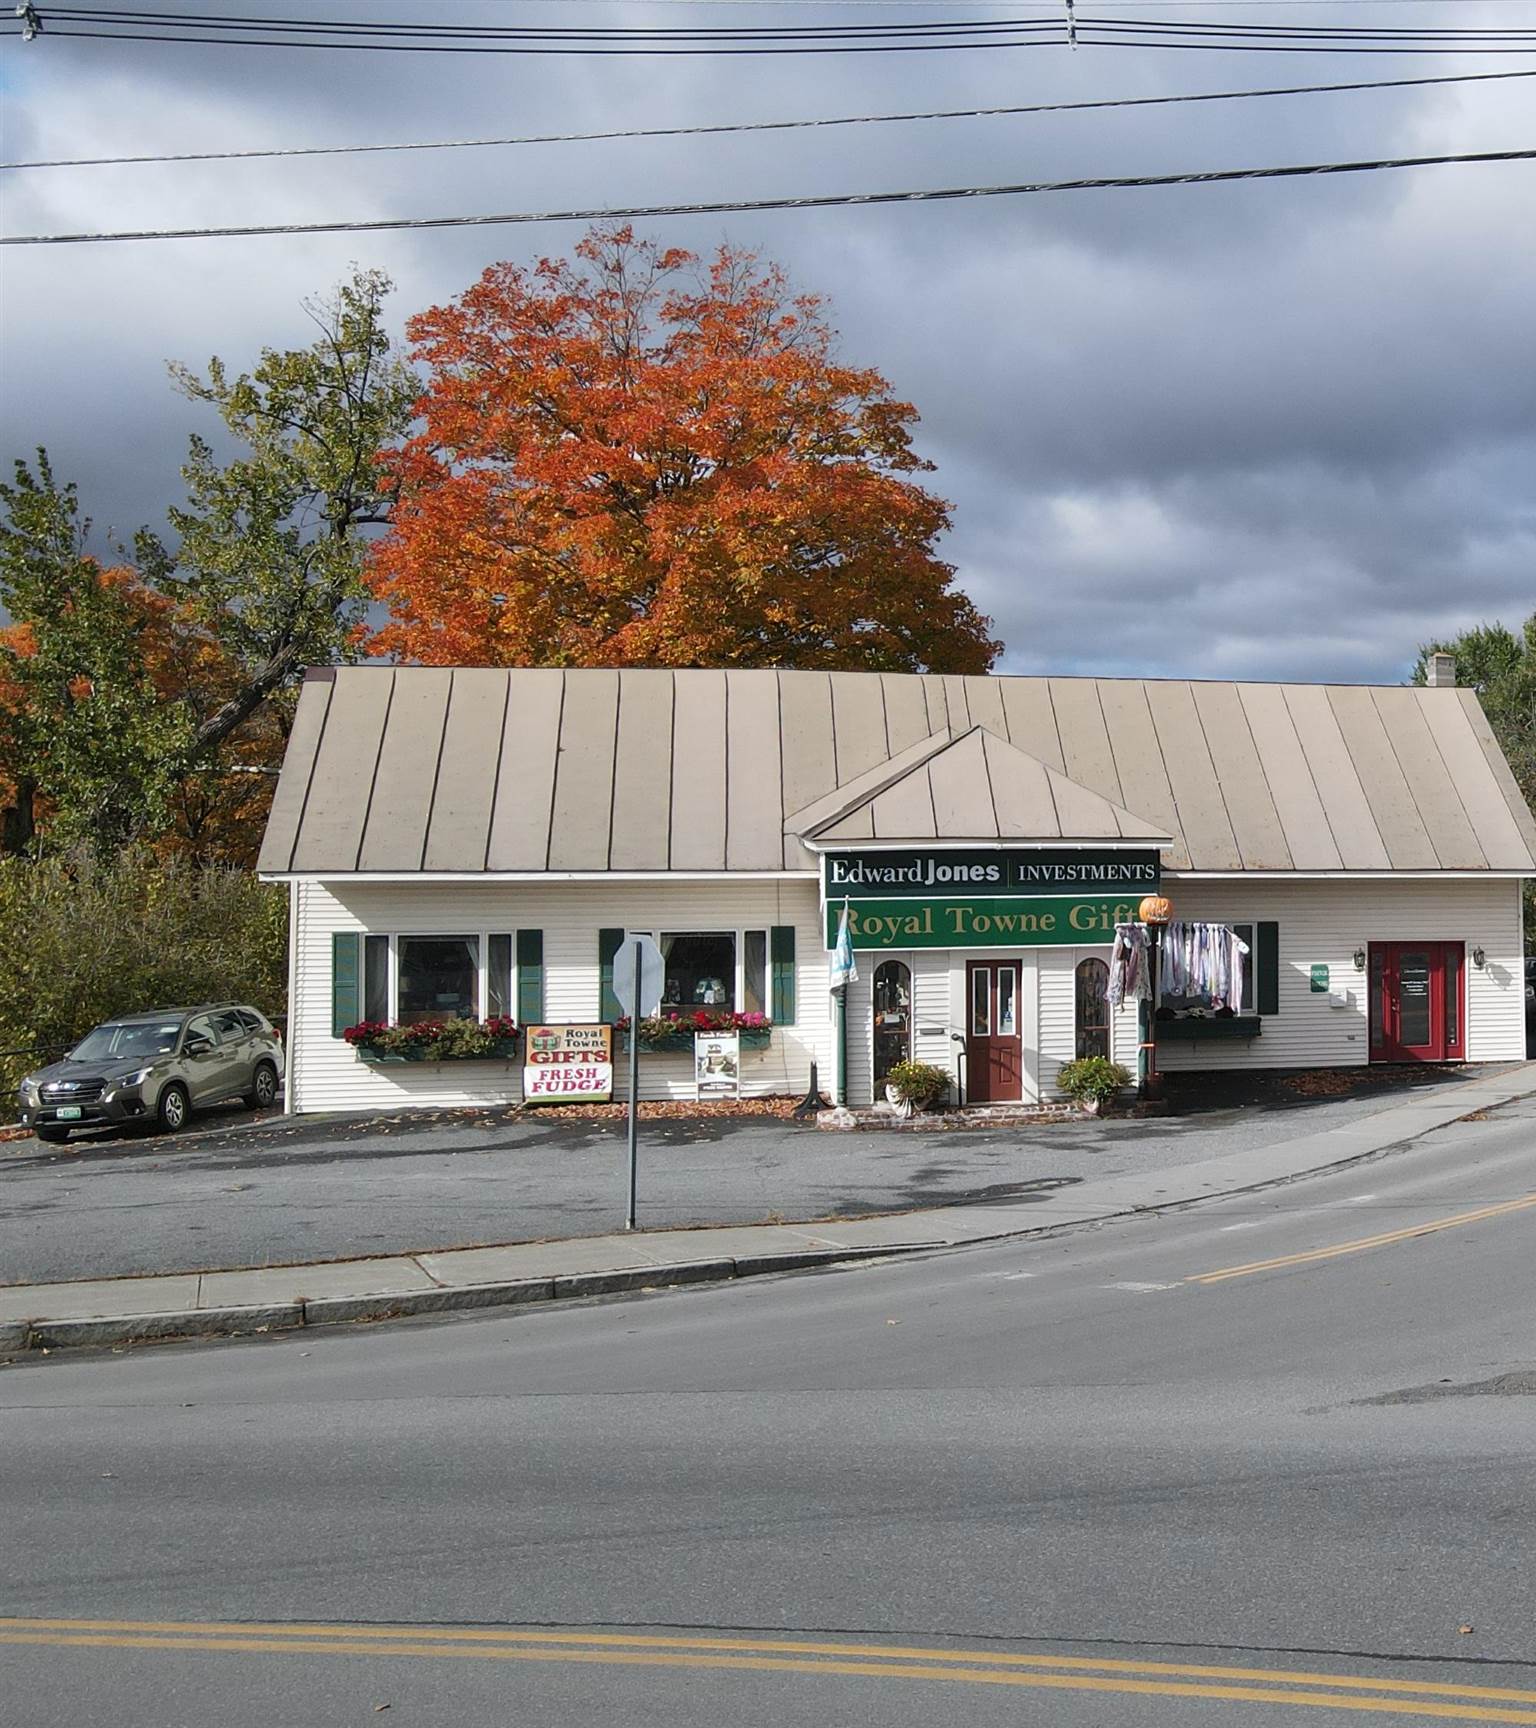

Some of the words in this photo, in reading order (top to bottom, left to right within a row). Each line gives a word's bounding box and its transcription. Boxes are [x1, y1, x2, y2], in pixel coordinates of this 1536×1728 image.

[1018, 863, 1156, 882] INVESTMENTS
[833, 907, 935, 944] Royal
[946, 907, 1057, 934] Towne
[1068, 904, 1139, 931] Gift
[565, 1028, 603, 1040] Royal
[564, 1038, 607, 1048] Towne
[530, 1050, 609, 1064] GIFTS
[539, 1068, 598, 1081] FRESH
[531, 1079, 606, 1093] FUDGE
